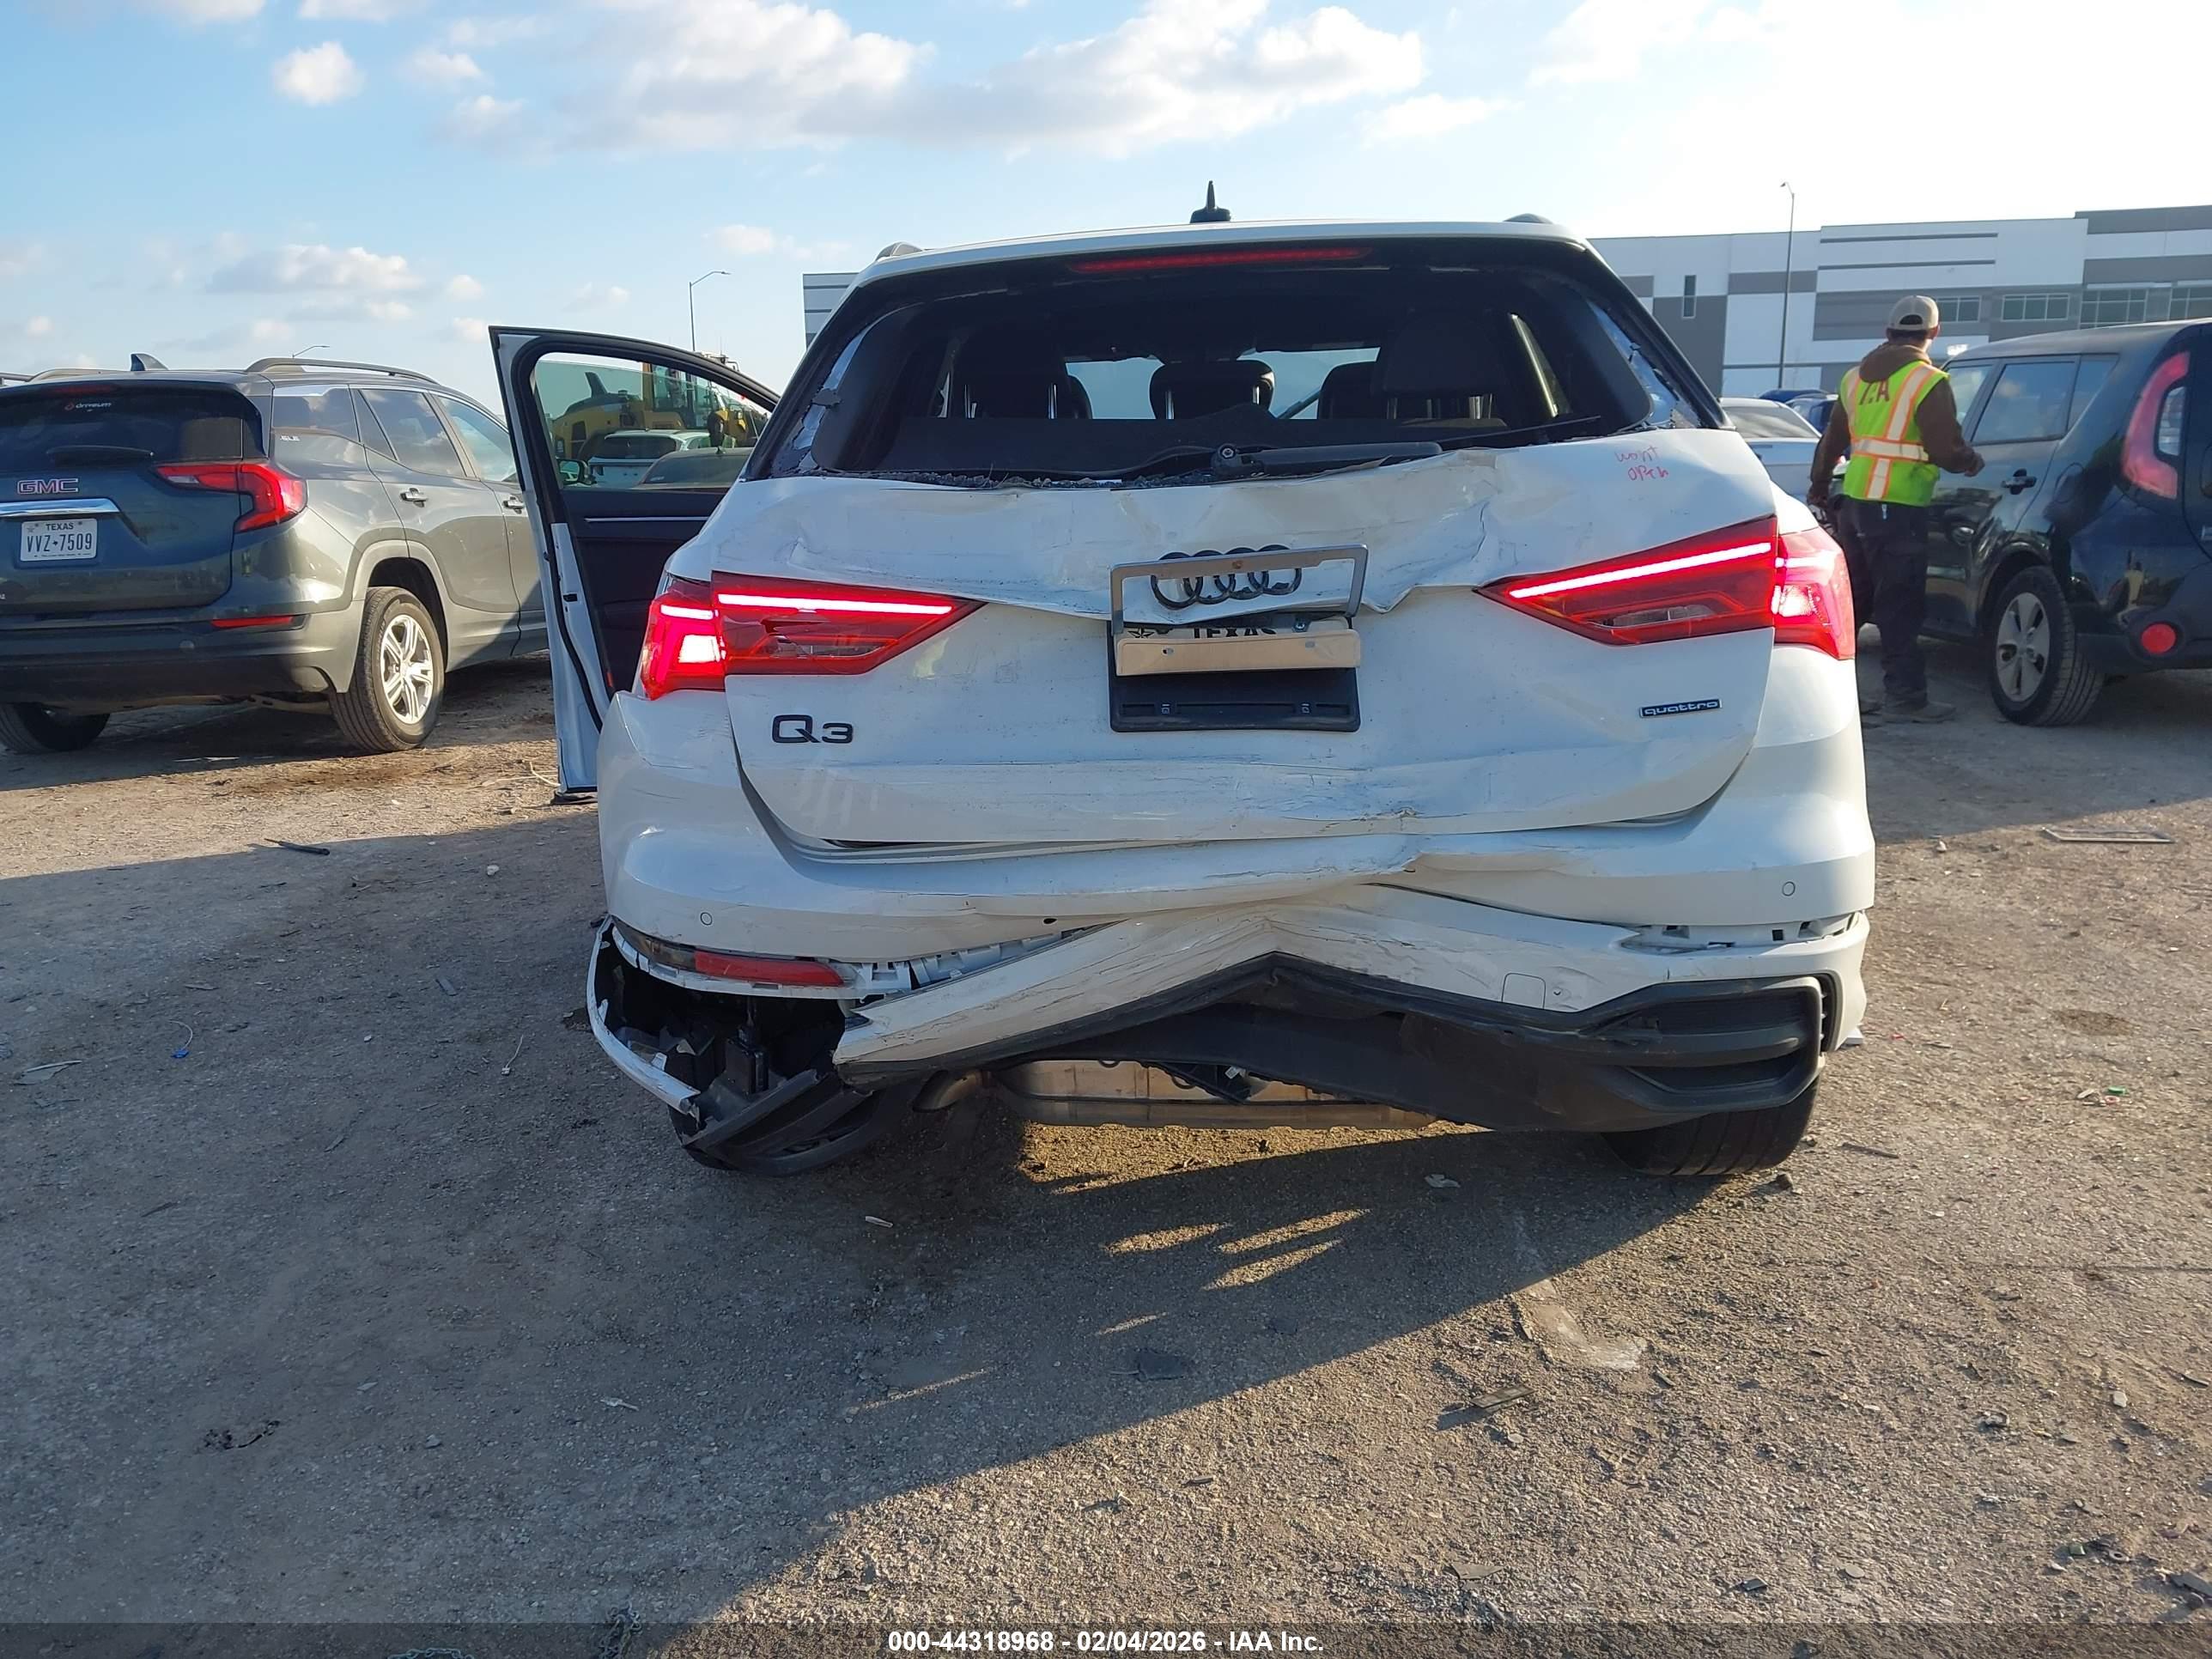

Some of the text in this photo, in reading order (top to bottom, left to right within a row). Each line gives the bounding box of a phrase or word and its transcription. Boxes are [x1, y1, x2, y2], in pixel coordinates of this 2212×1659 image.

[17, 477, 79, 495] GMC
[46, 522, 74, 532] TEXAS
[1644, 701, 1719, 715] quattro
[771, 714, 854, 744] Q3
